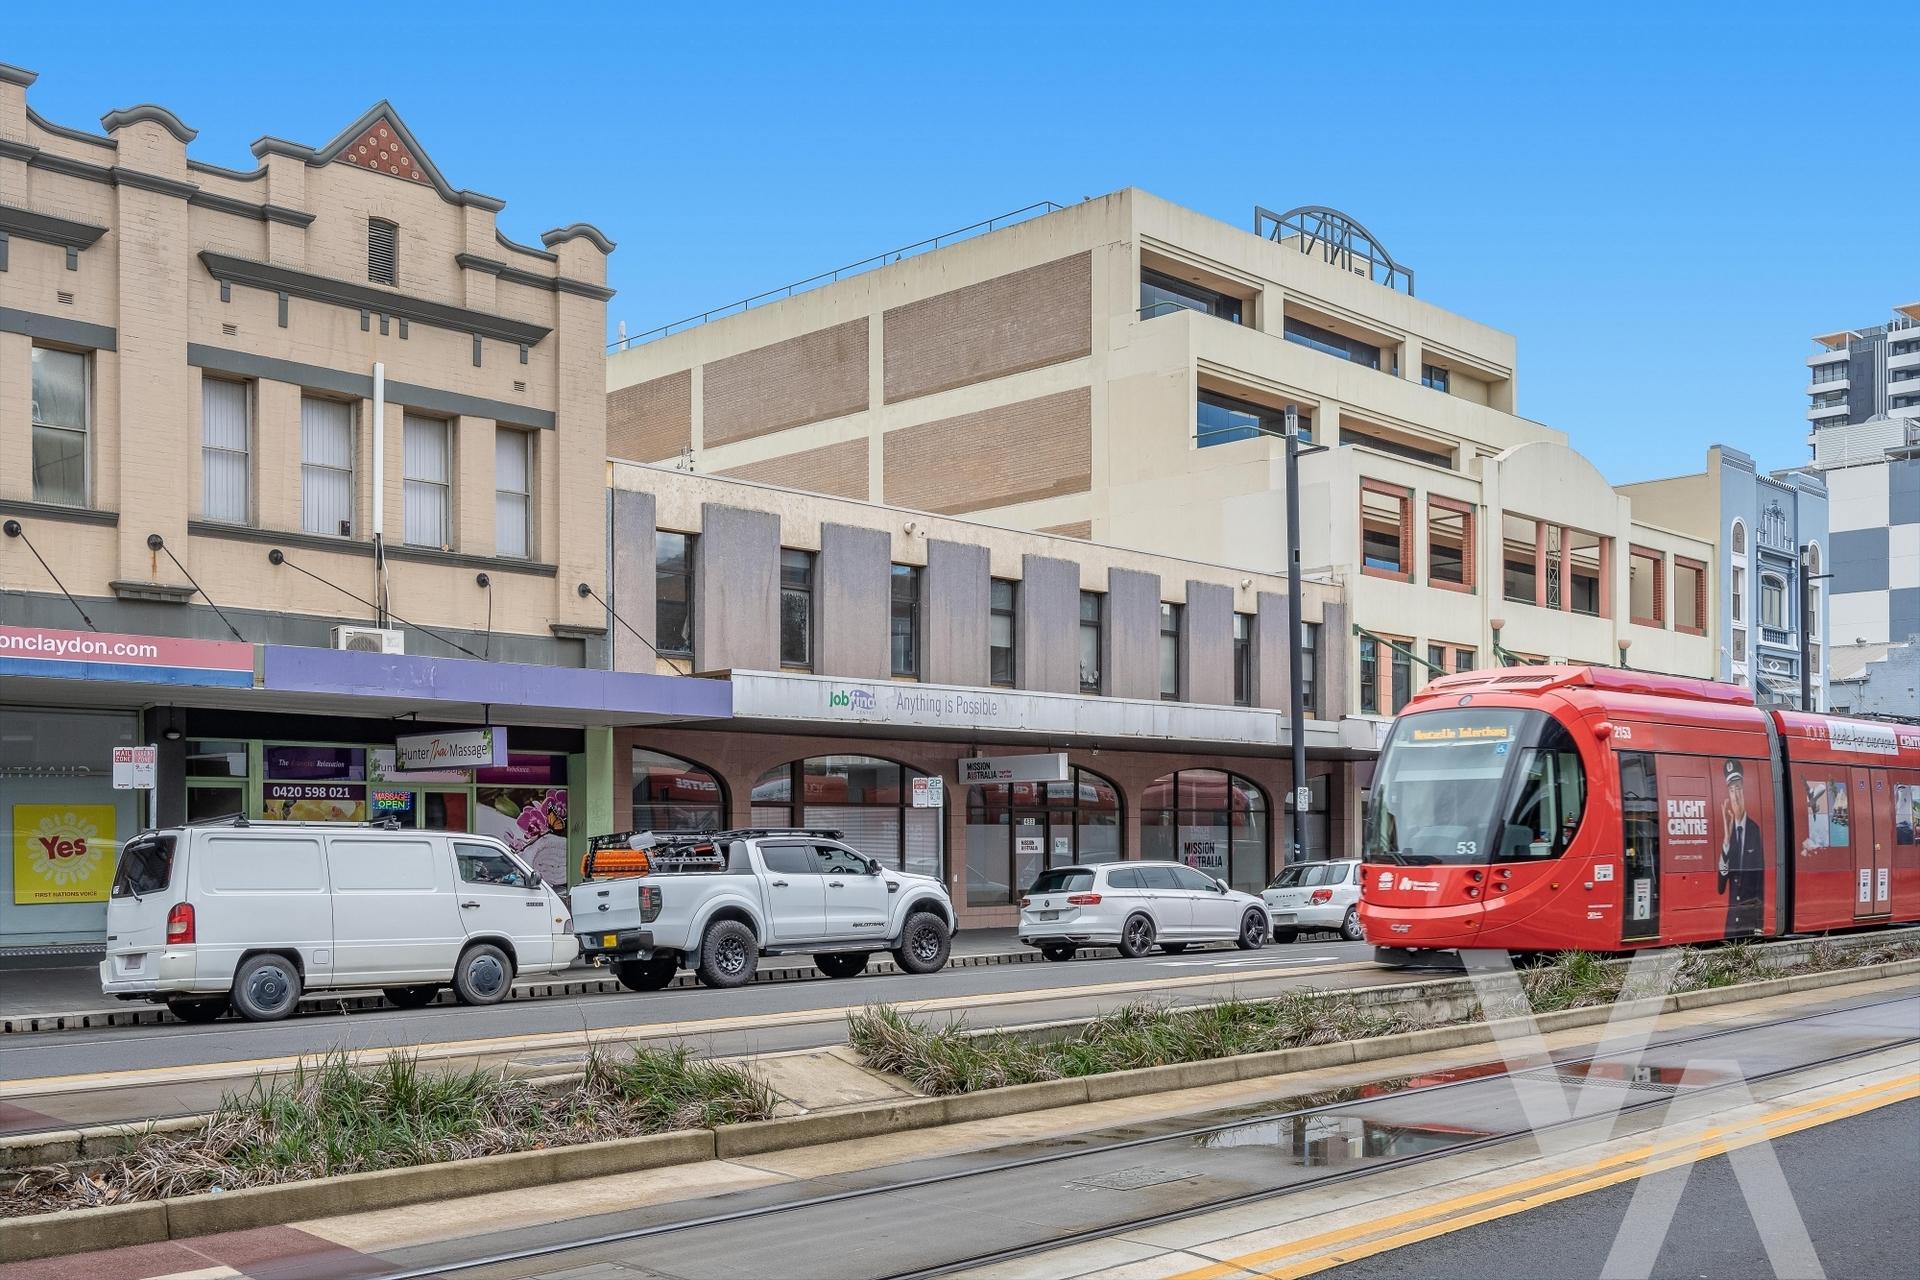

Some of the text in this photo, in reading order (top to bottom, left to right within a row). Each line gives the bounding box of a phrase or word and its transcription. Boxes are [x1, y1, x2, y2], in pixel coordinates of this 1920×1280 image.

[896, 692, 942, 717] Anything
[944, 694, 953, 713] is
[956, 695, 998, 716] Possible
[1613, 725, 1632, 739] 2153
[401, 739, 488, 765] Hunter Thai Massage
[966, 761, 991, 771] MISSION
[929, 779, 942, 787] 2P
[272, 786, 350, 798] 0420 598 021
[375, 792, 408, 800] MASSAGE
[378, 800, 405, 809] OPEN
[1667, 800, 1706, 818] FLIGHT
[1667, 818, 1708, 835] CENTRE
[38, 836, 87, 860] Yes
[1184, 841, 1215, 854] MISSION
[1456, 841, 1477, 855] 53
[1184, 855, 1223, 867] AUSTRALIA
